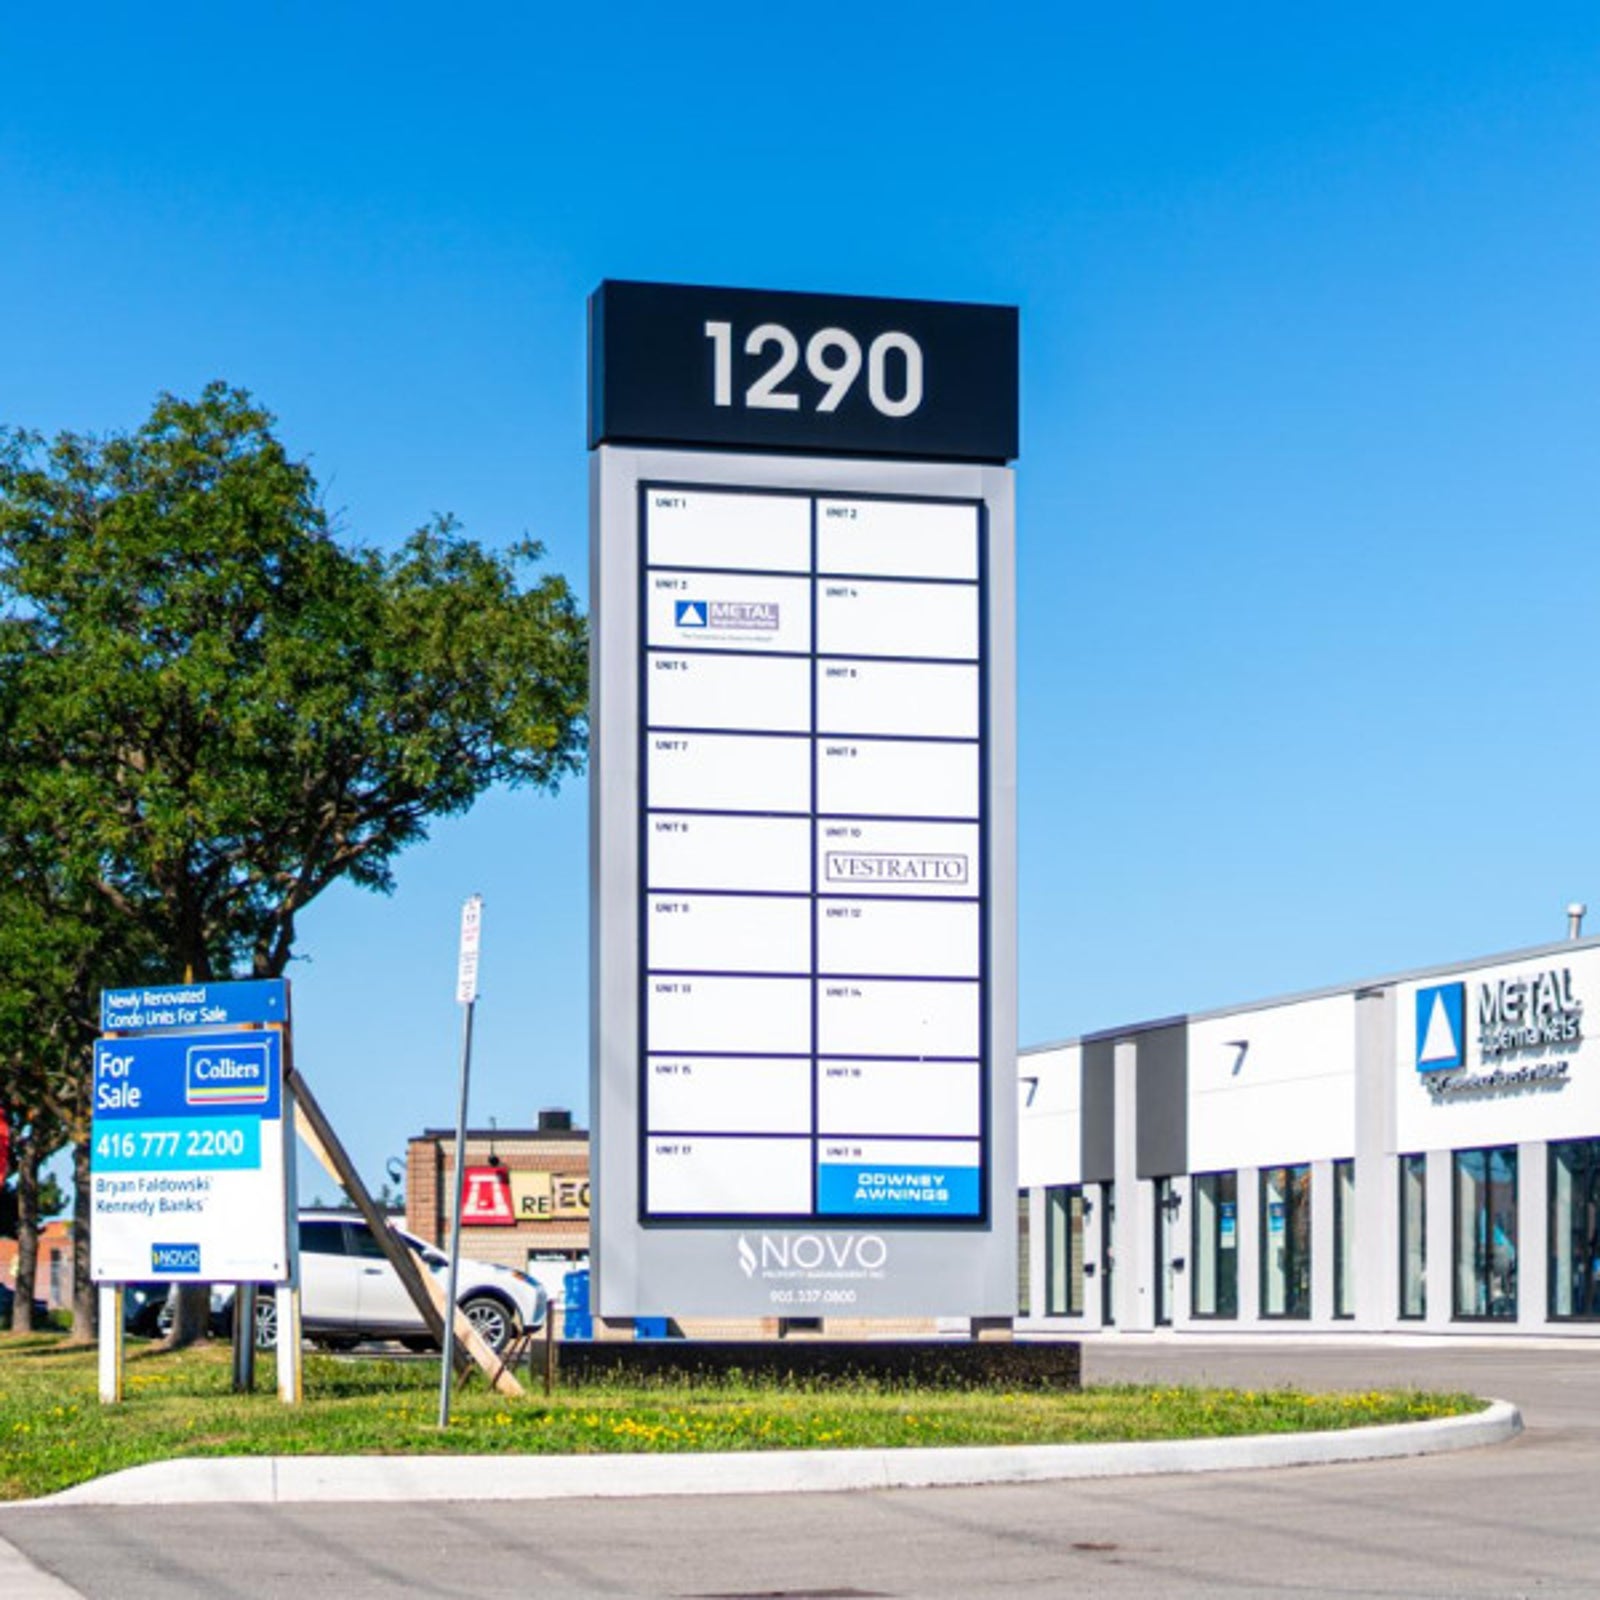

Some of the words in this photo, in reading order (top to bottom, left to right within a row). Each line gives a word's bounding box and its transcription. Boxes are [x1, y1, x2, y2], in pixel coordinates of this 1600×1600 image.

[704, 320, 924, 418] 1290
[656, 498, 679, 508] UNIT
[682, 499, 687, 508] 1
[826, 508, 848, 518] UNIT
[850, 509, 857, 519] 2
[656, 580, 678, 589] UNIT
[826, 588, 848, 597] UNIT
[850, 589, 858, 598] 4
[656, 660, 678, 670] UNIT
[826, 668, 848, 677] UNIT
[656, 741, 679, 750] UNIT
[681, 741, 688, 750] 7
[826, 747, 848, 756] UNIT
[656, 822, 678, 832] UNIT
[826, 828, 848, 837] UNIT
[851, 828, 862, 838] 10
[833, 857, 962, 878] VESTRATTO
[656, 903, 678, 912] UNIT
[826, 908, 848, 917] UNIT
[851, 909, 862, 918] 12
[656, 984, 678, 992] UNIT
[826, 988, 848, 996] UNIT
[851, 988, 862, 997] 14
[107, 993, 141, 1010] Newly
[143, 987, 207, 1006] Renovated
[1479, 968, 1576, 1025] METAL
[106, 1010, 144, 1028] Condo
[146, 1009, 177, 1025] Units
[178, 1008, 197, 1023] For
[200, 1005, 228, 1022] Sale
[99, 1052, 135, 1078] For
[195, 1058, 260, 1080] Colliers
[656, 1065, 678, 1074] UNIT
[682, 1065, 692, 1074] 15
[826, 1068, 848, 1077] UNIT
[97, 1082, 142, 1109] Sale
[97, 1132, 136, 1158] 416
[140, 1132, 181, 1157] 777
[186, 1130, 244, 1156] 2200
[656, 1145, 678, 1154] UNIT
[682, 1146, 692, 1154] 17
[826, 1148, 848, 1156] UNIT
[857, 1171, 945, 1187] DOWNEY
[96, 1178, 136, 1197] Bryan
[854, 1187, 949, 1201] AWNINGS
[96, 1198, 155, 1217] Kennedy
[159, 1197, 204, 1213] Banks
[761, 1234, 888, 1269] NOVO
[159, 1249, 199, 1266] NOVO
